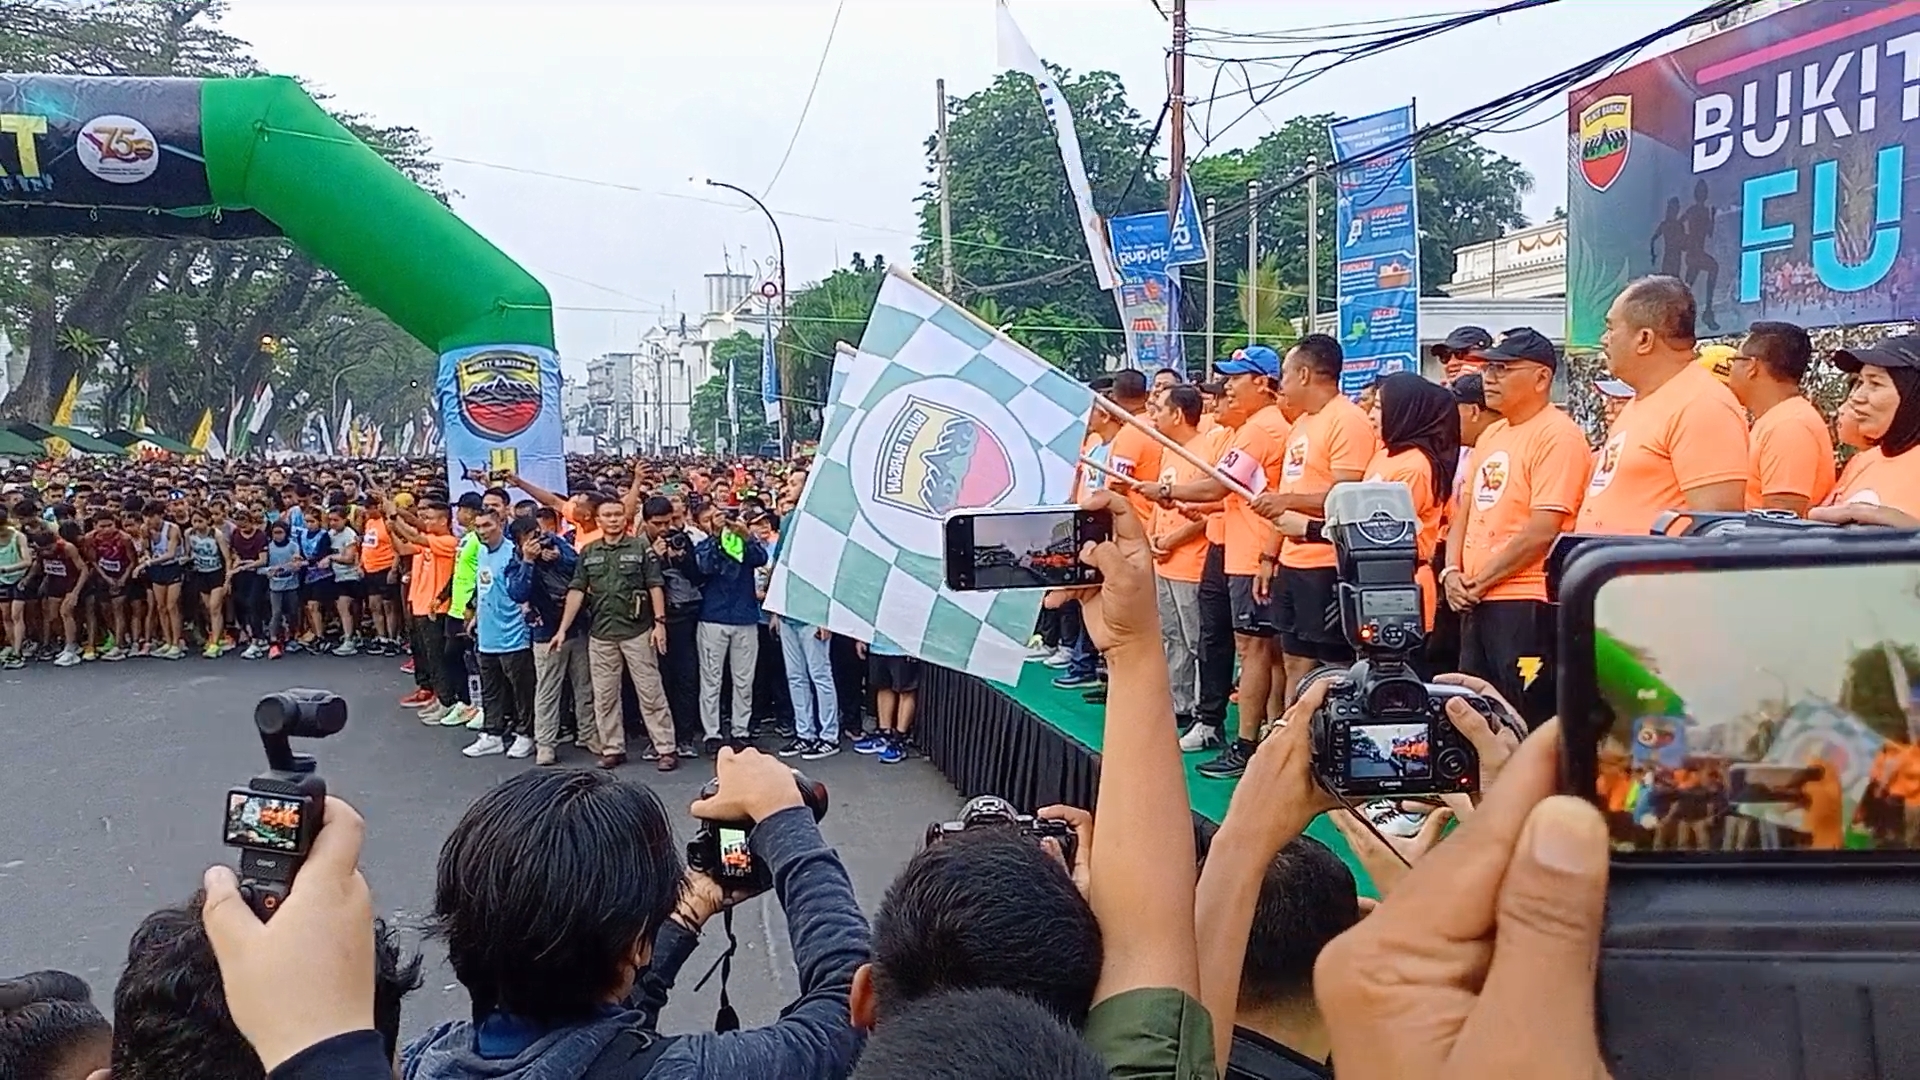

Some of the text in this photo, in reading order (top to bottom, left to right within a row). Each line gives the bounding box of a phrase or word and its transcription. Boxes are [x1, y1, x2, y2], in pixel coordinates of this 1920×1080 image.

[0, 113, 48, 178] T
[1693, 31, 1920, 173] BUKIT
[1739, 145, 1905, 303] FU
[1378, 780, 1402, 788] Canon
